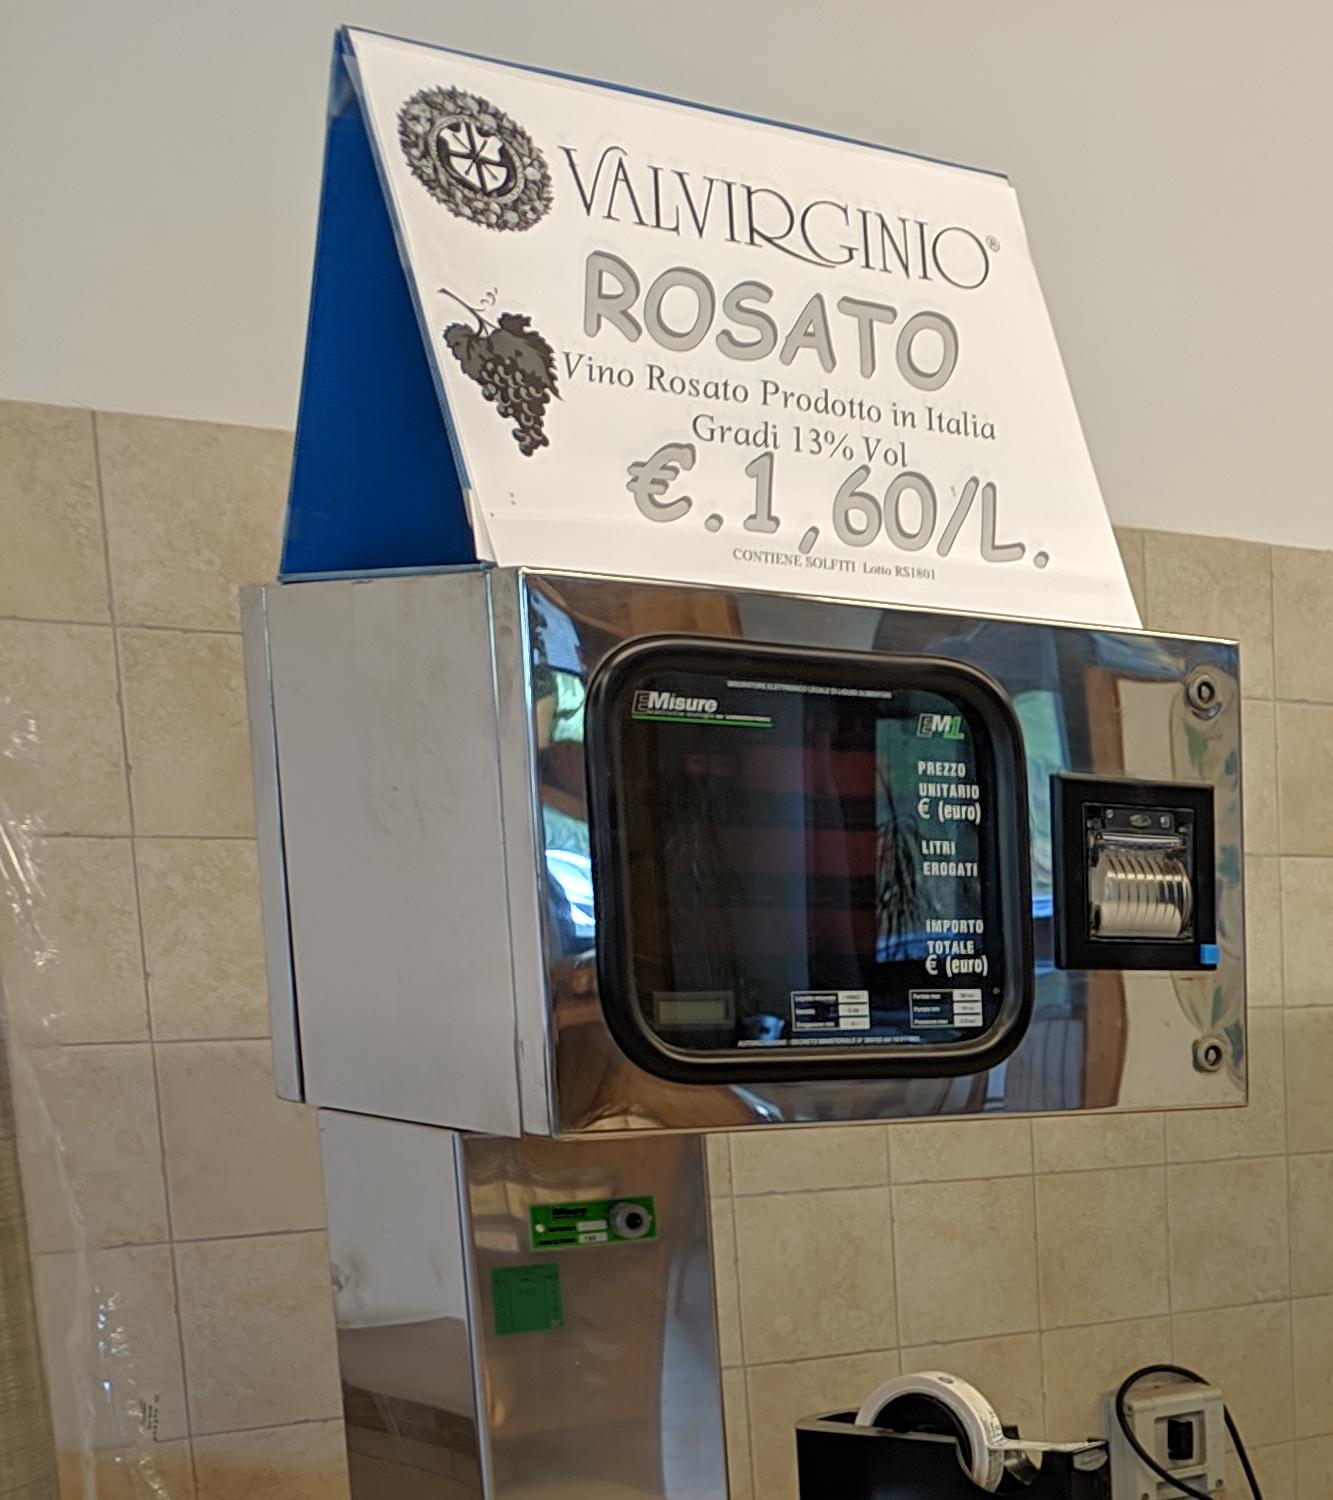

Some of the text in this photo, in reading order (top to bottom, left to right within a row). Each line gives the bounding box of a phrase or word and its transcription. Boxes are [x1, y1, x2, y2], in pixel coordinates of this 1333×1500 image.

[559, 146, 991, 290] VALVIRGINIO
[583, 250, 959, 392] ROSATO
[562, 352, 997, 441] Vino Rosato Prodotto in Italia
[692, 413, 908, 468] Gradi 13% Vol
[732, 548, 802, 568] CONTIENE
[805, 555, 857, 574] SOLFITI
[863, 561, 892, 578] Lotto
[917, 760, 966, 777] PREZZO
[918, 782, 980, 800] UNITARIO
[917, 798, 982, 826] € (euro)
[921, 840, 956, 856] LITRI
[922, 861, 978, 878] EROGATI
[925, 918, 984, 935] IMPORTO
[926, 940, 975, 955] TOTALE
[925, 954, 988, 978] € (euro)
